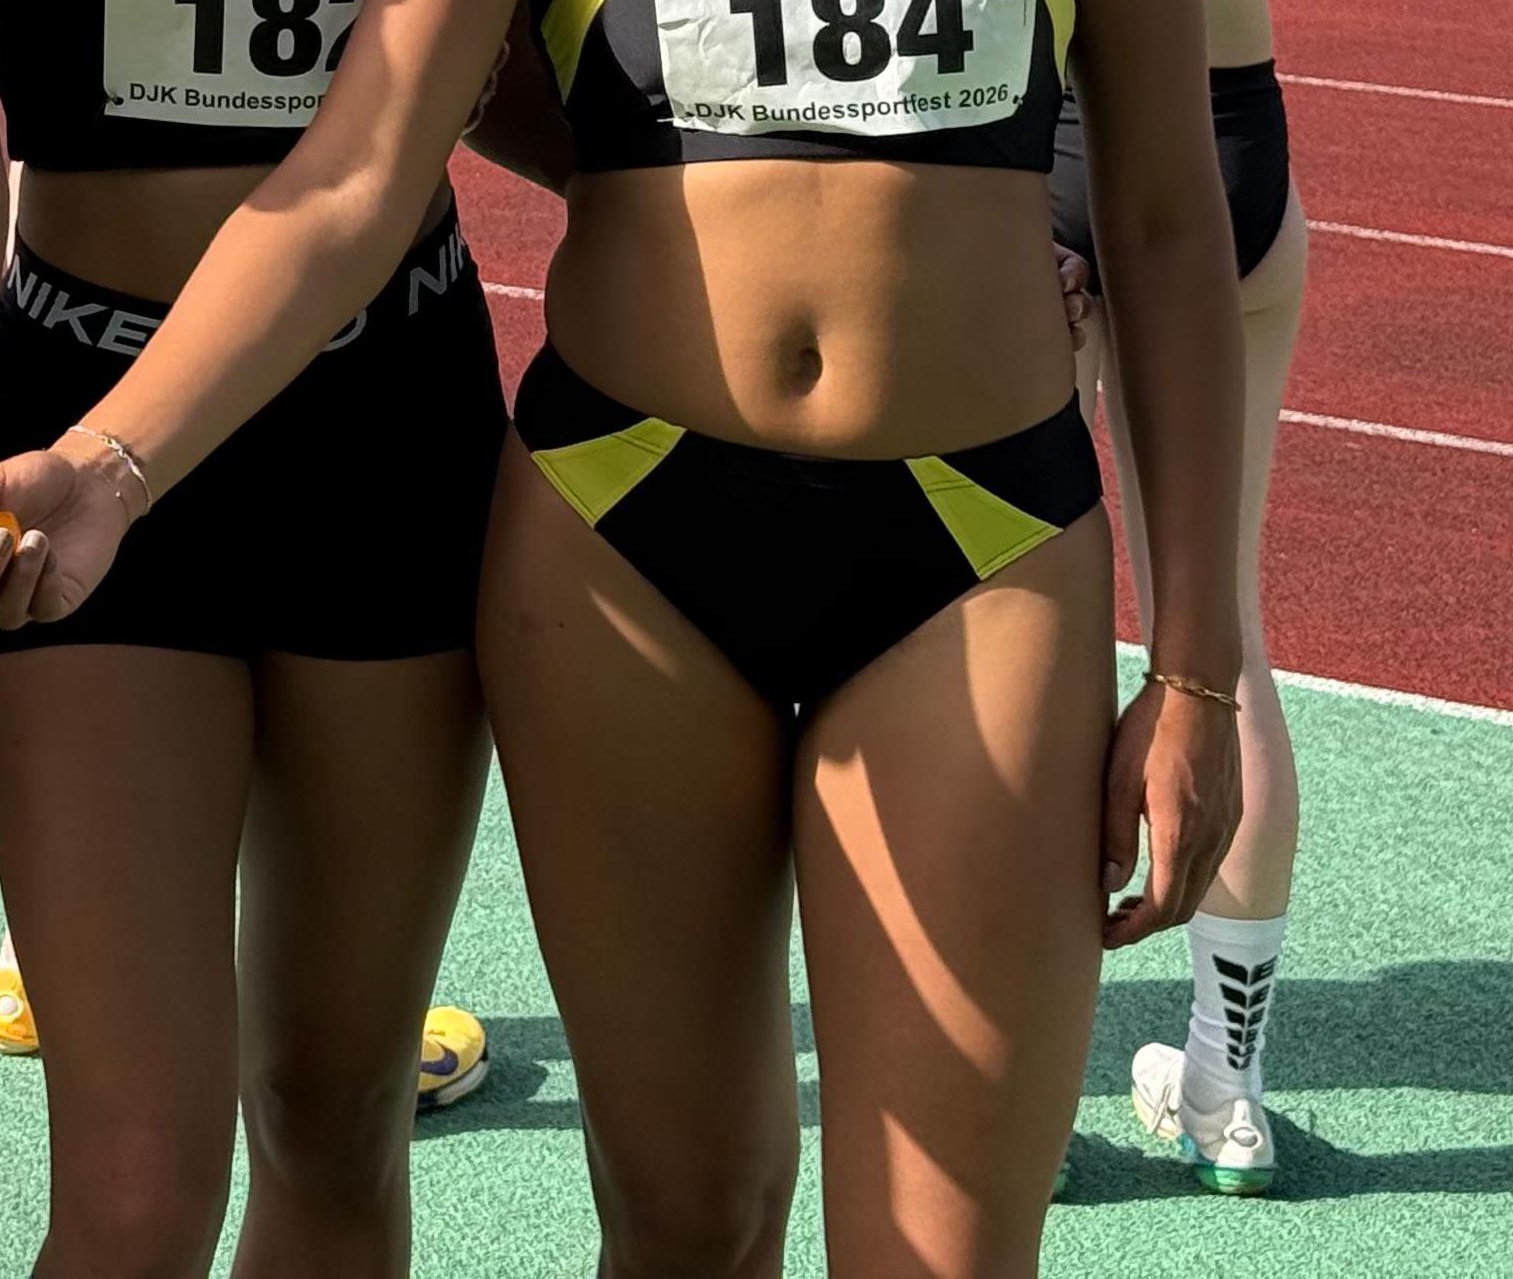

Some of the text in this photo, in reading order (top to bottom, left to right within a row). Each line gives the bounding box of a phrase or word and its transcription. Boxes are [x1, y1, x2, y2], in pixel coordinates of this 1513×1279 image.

[129, 82, 326, 114] DJK Bundesspor
[694, 83, 1010, 123] DJK Bundessportfest 2026
[6, 253, 164, 356] NIKE
